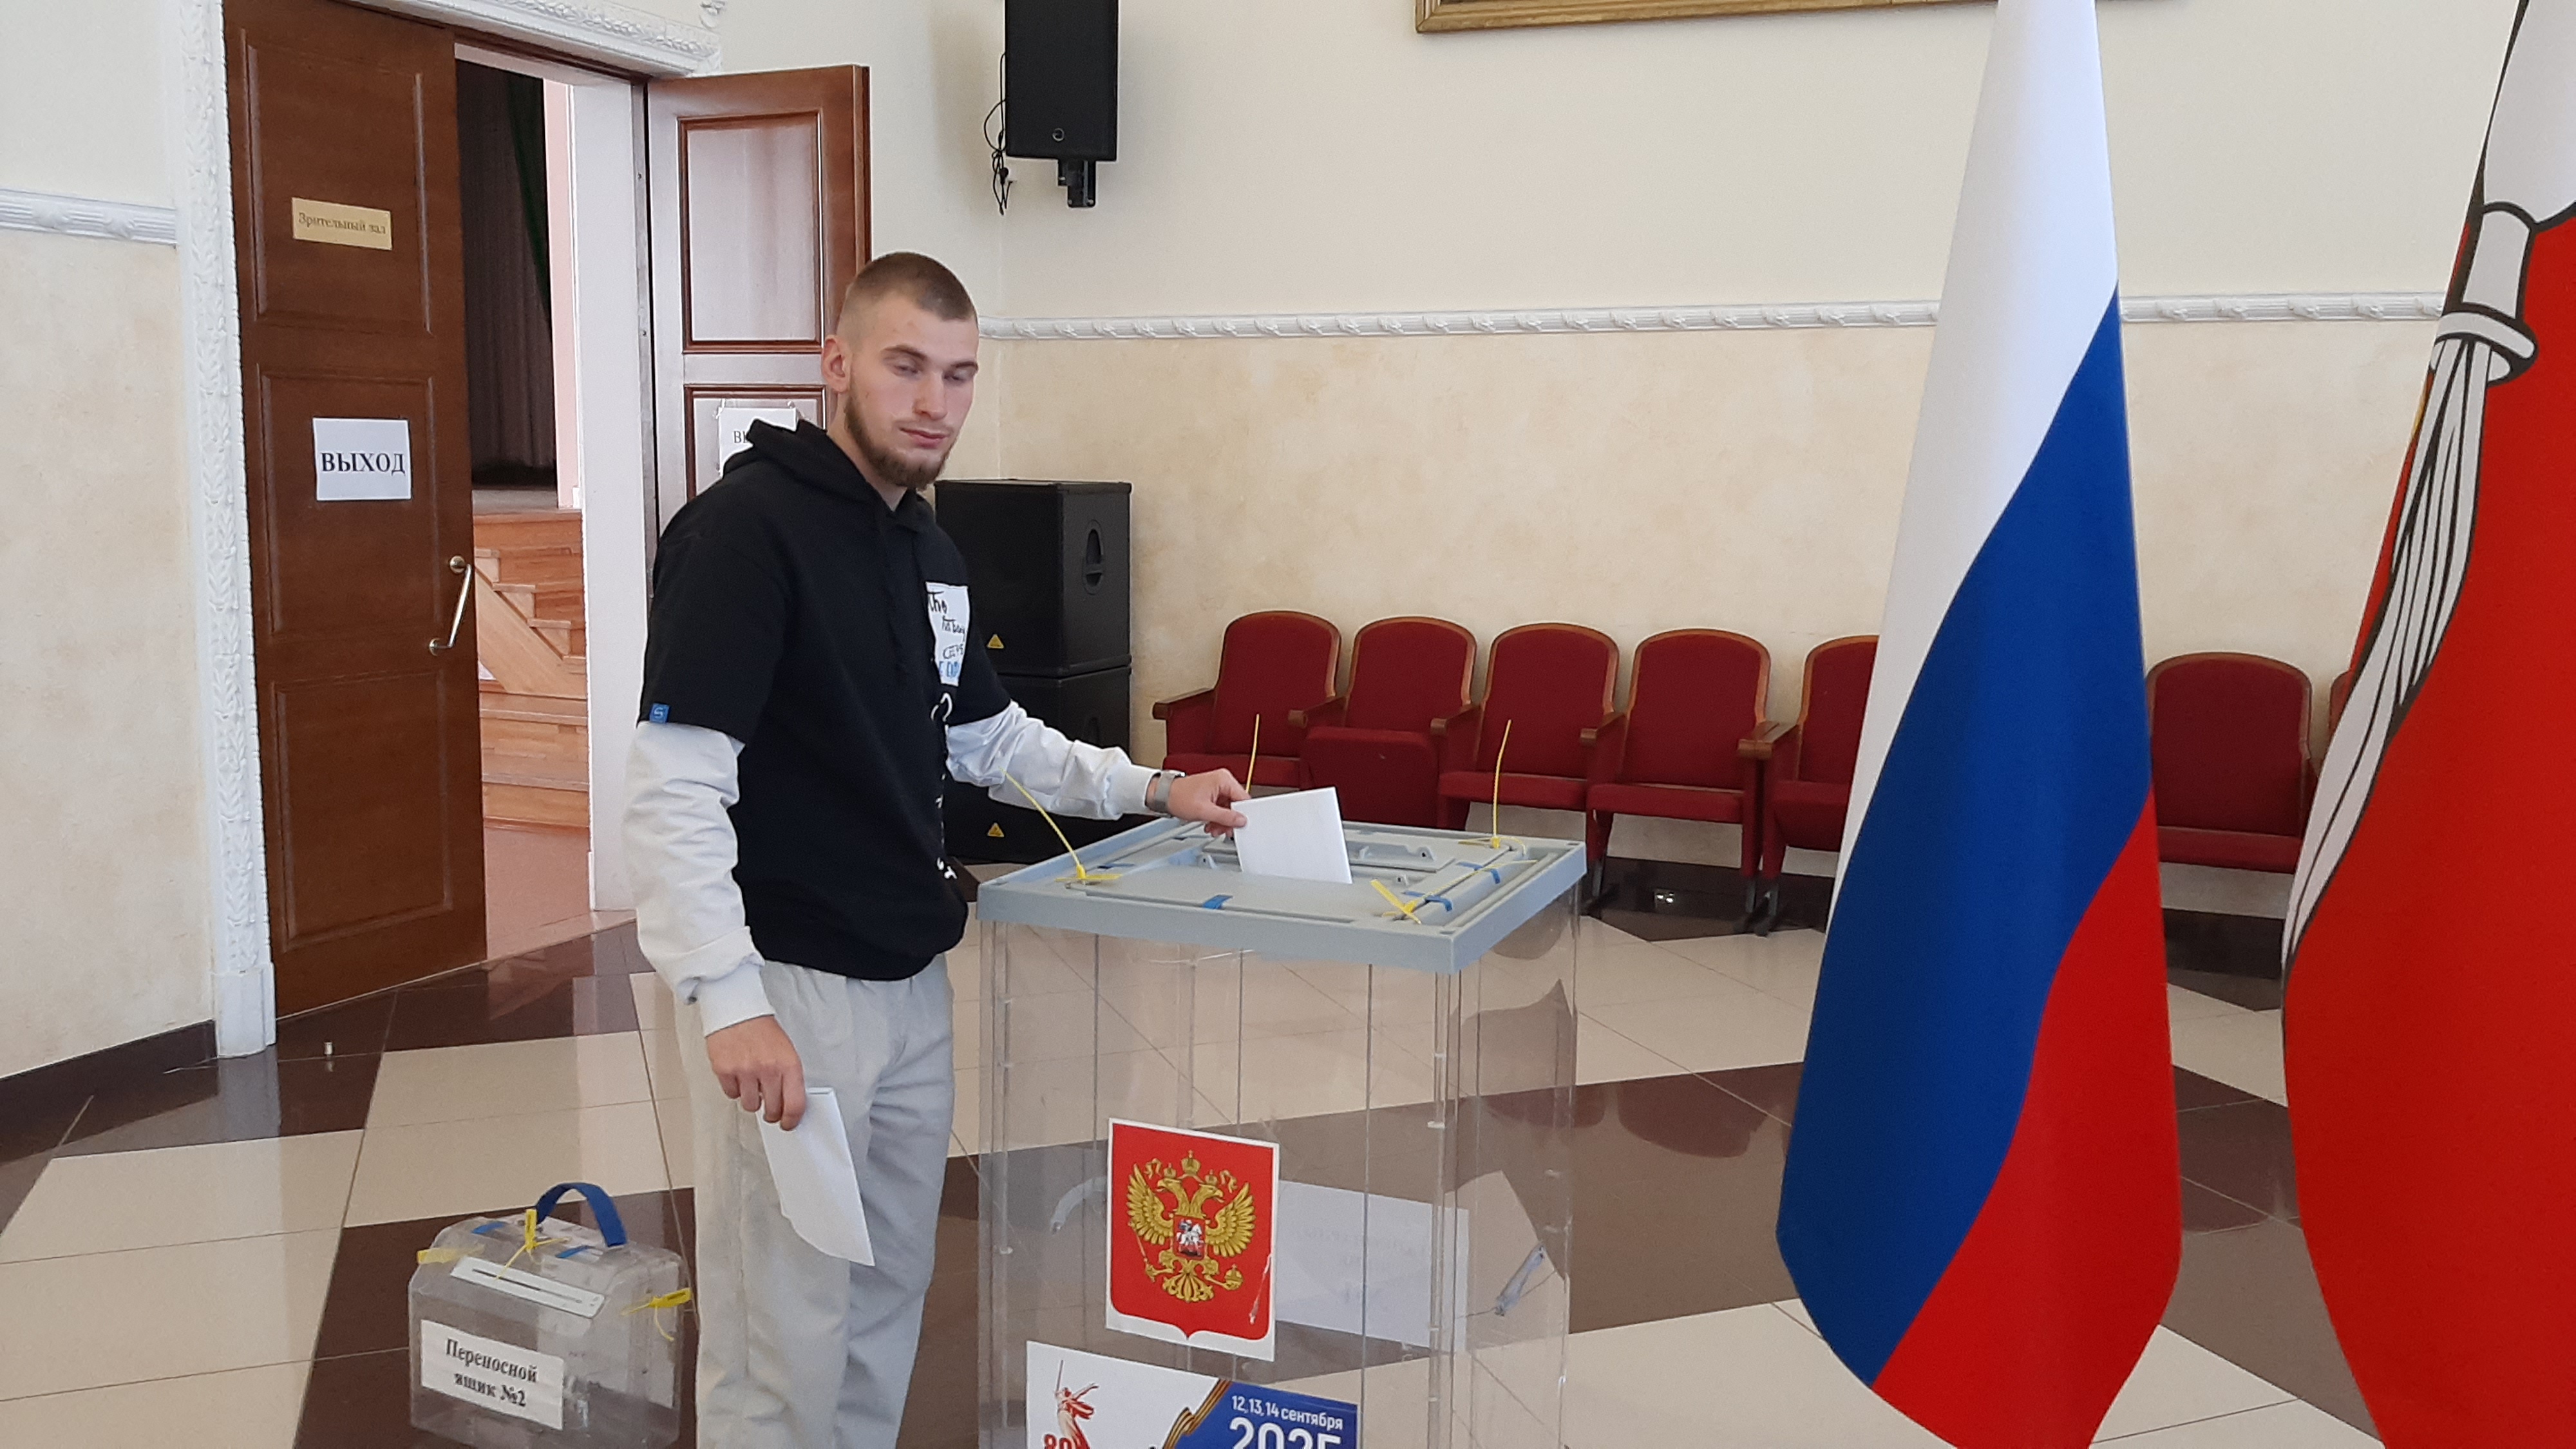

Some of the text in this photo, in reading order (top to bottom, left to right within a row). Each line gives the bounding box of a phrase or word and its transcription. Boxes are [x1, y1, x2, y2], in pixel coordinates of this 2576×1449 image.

[298, 212, 386, 234] Зрительный зал
[320, 452, 406, 477] ВЫХОД
[446, 1338, 538, 1383] Переносной
[453, 1372, 527, 1407] ящик №2
[1280, 1408, 1344, 1432] сентября
